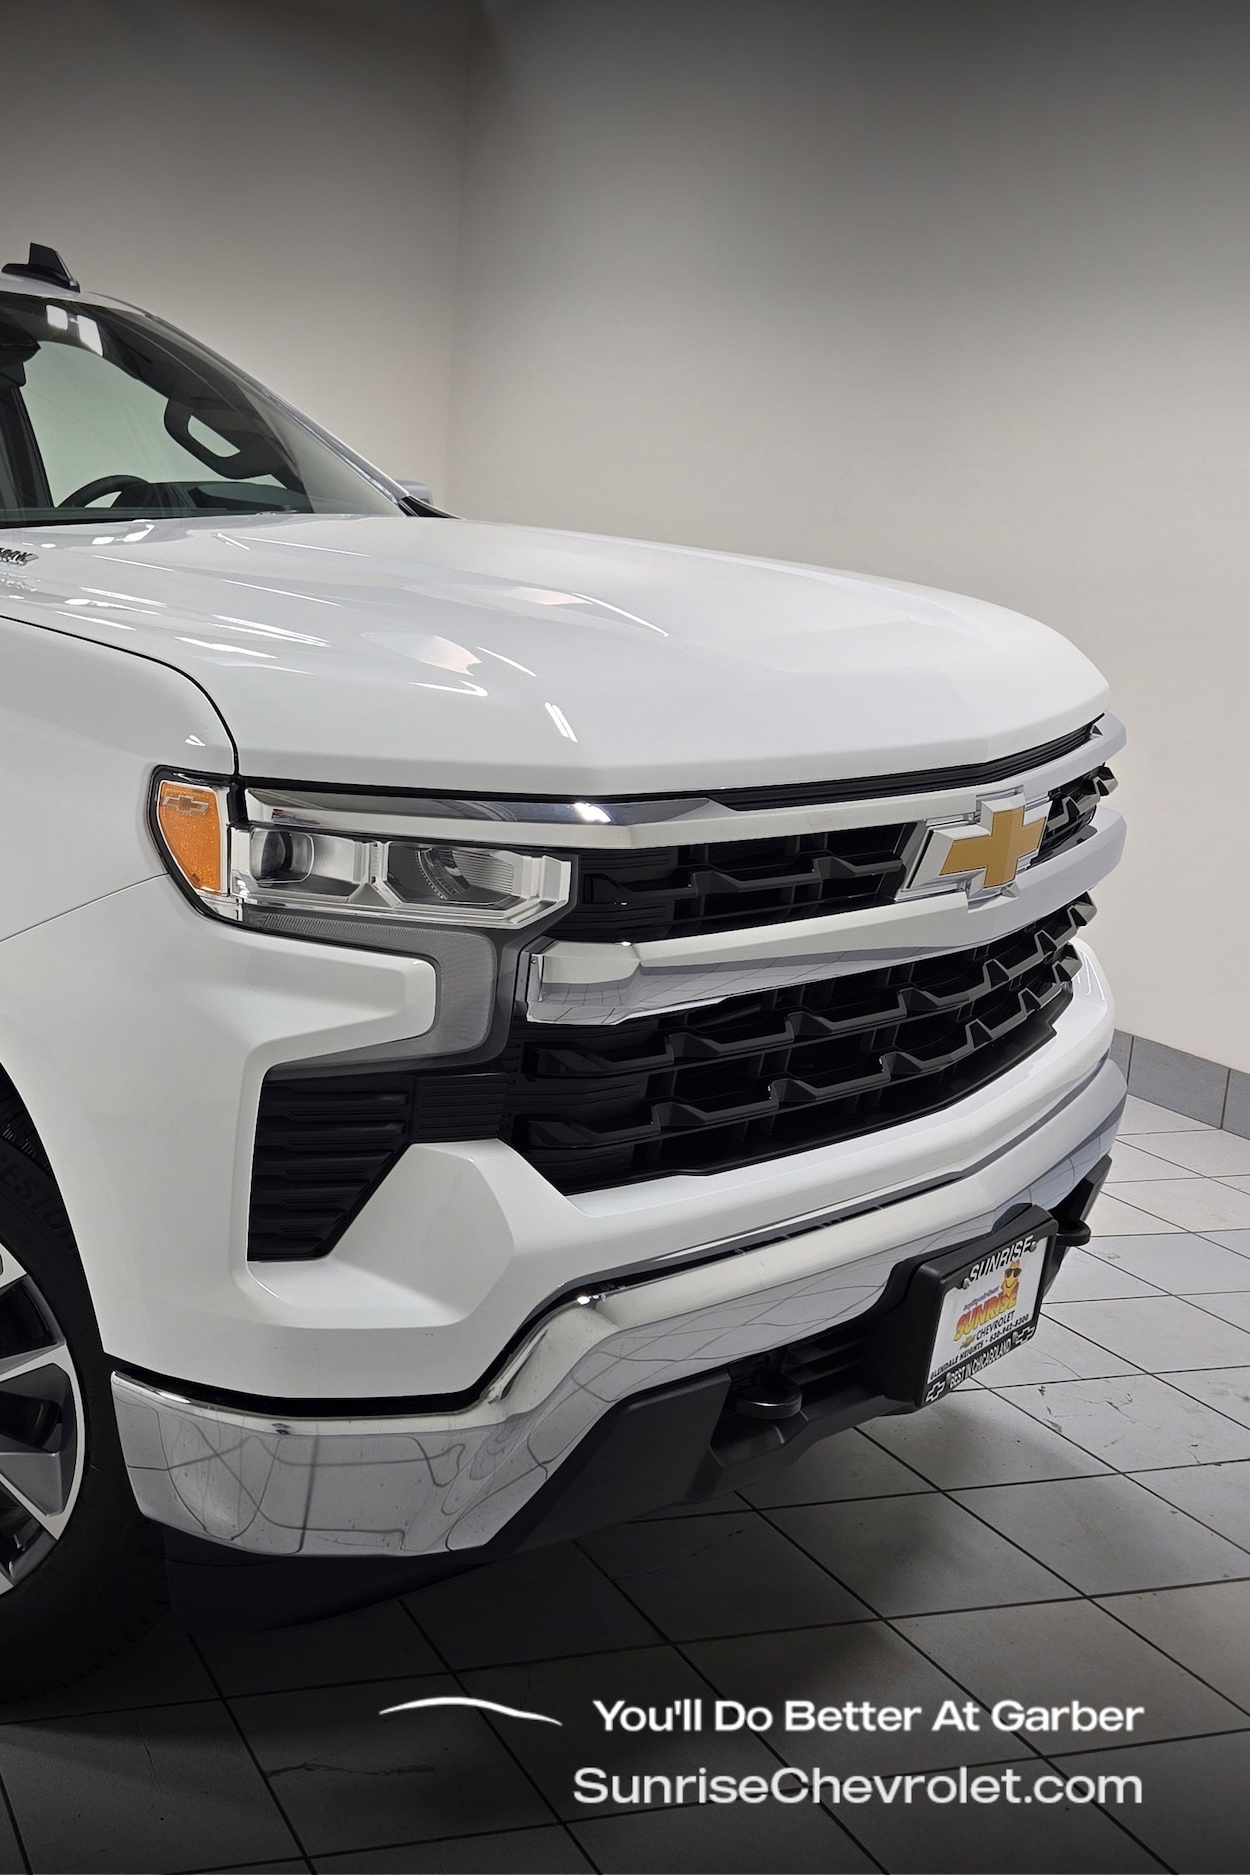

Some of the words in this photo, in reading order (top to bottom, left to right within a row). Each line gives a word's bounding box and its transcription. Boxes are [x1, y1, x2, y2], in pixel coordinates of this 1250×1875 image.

[969, 1234, 1035, 1283] SUNRISE
[953, 1290, 1017, 1342] SUNRISE
[976, 1310, 1015, 1341] CHEVROLET
